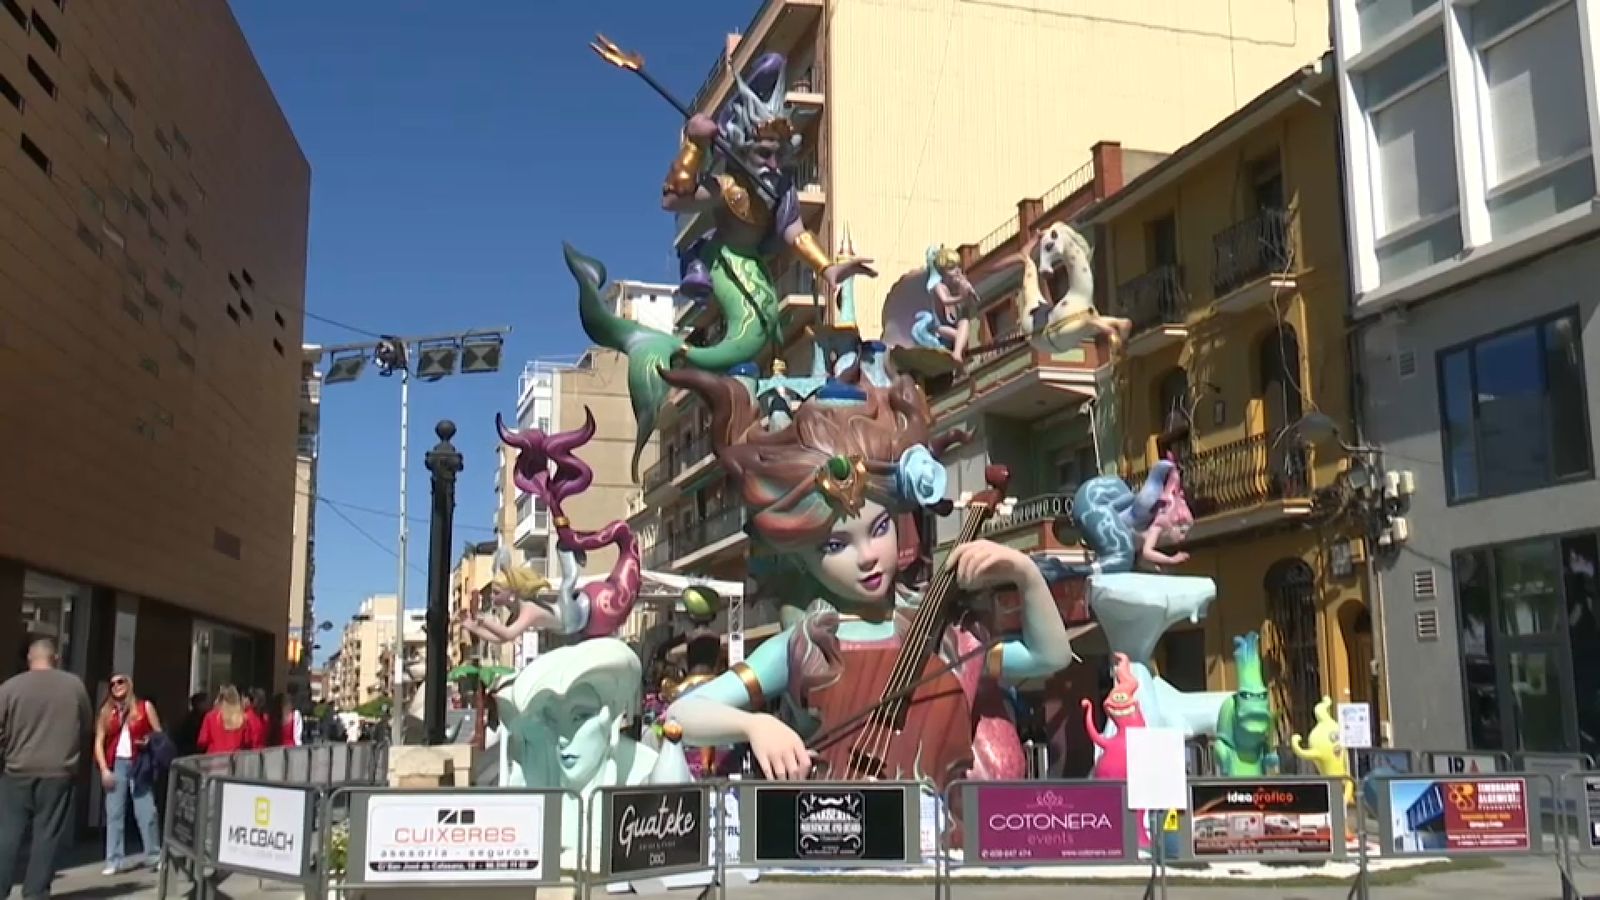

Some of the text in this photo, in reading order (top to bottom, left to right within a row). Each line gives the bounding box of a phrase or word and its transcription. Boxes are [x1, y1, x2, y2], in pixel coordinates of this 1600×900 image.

[619, 794, 696, 858] Guateke
[989, 813, 1112, 830] COTONERA
[1027, 831, 1074, 845] events
[469, 848, 530, 857] seguros
